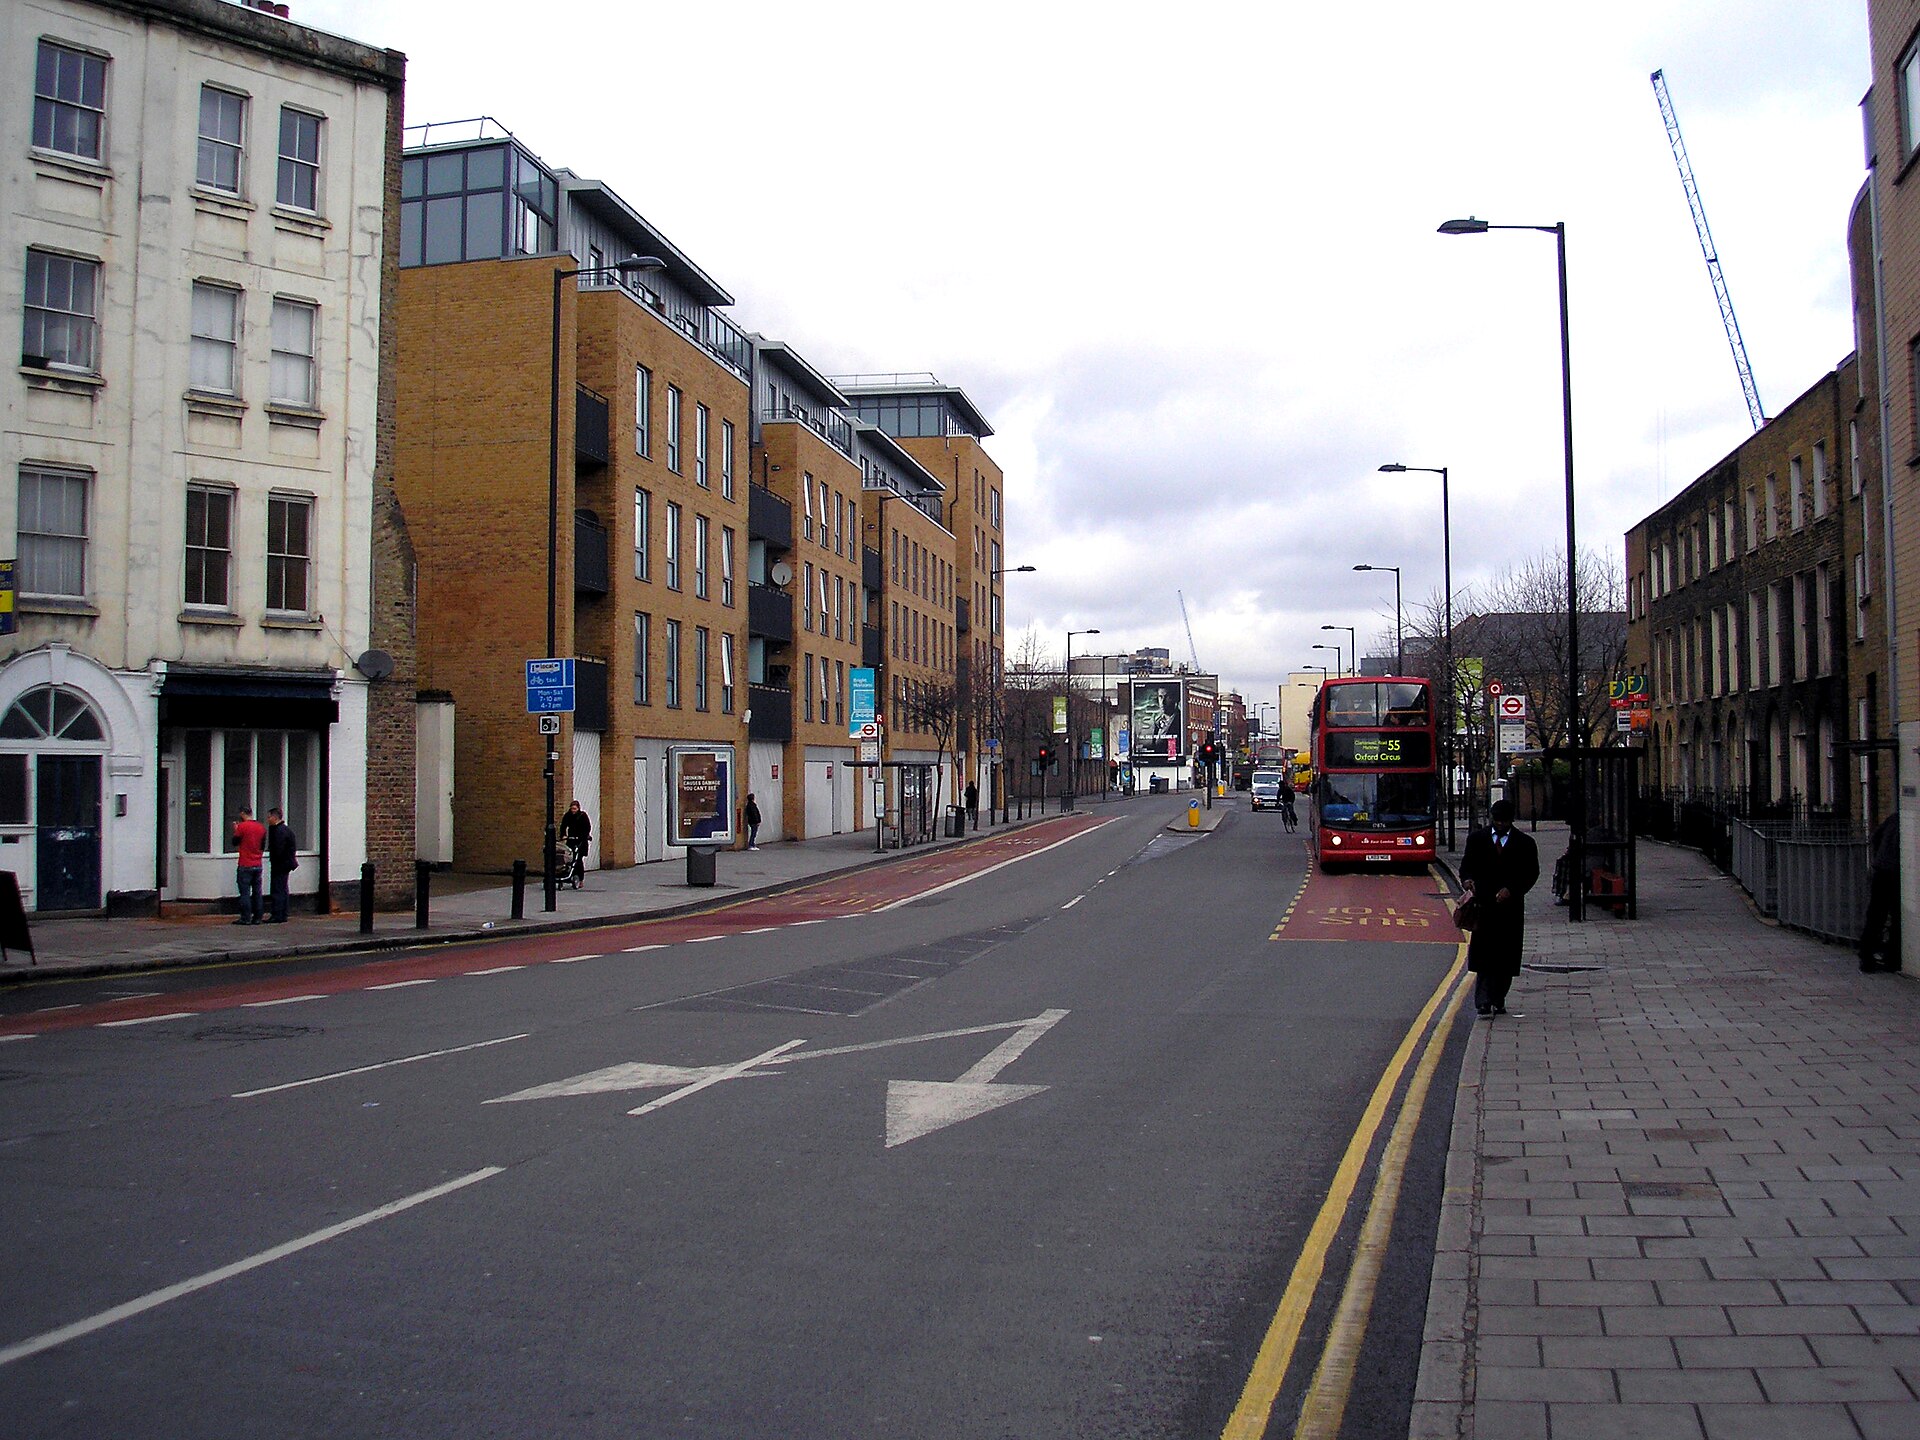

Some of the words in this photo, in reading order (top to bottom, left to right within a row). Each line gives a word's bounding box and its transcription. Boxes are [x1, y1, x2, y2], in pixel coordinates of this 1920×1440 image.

[1490, 684, 1500, 694] Q
[876, 714, 883, 722] R
[1387, 740, 1401, 751] 55
[1354, 753, 1379, 761] Oxford
[1380, 753, 1401, 761] Circus
[1306, 906, 1440, 917] STOP
[1318, 916, 1430, 927] BUS
